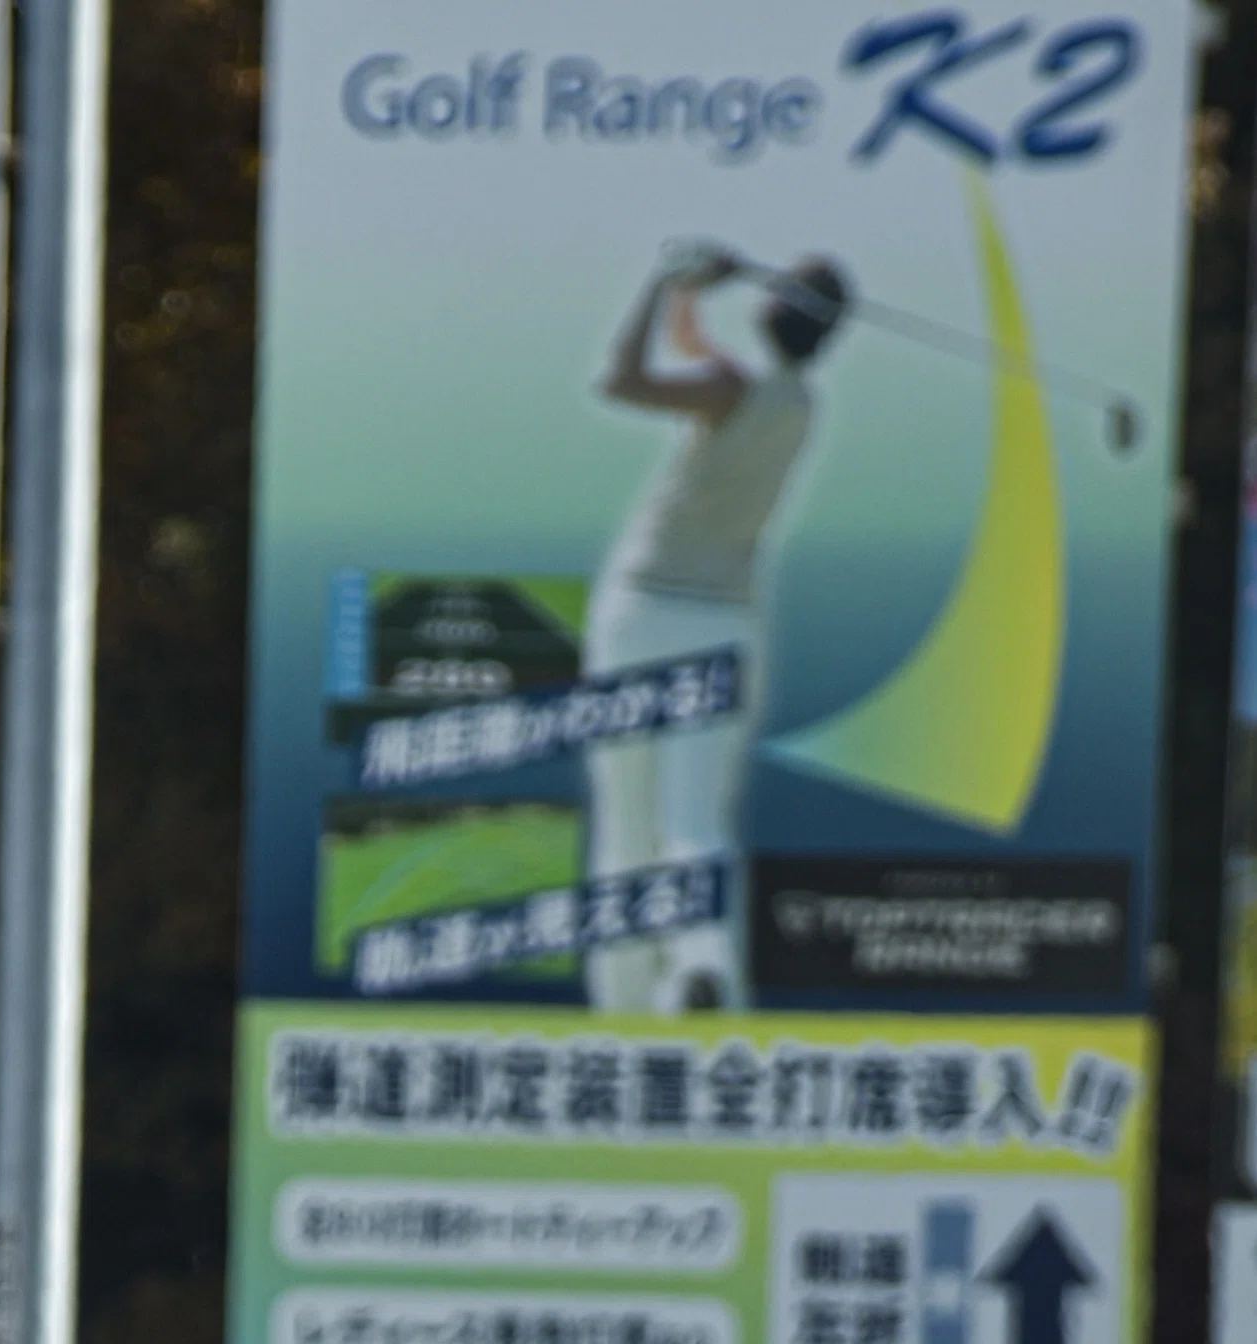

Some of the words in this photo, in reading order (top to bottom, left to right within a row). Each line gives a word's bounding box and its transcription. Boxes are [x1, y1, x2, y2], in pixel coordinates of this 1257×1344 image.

[343, 50, 526, 140] Golf
[545, 58, 822, 160] Range
[842, 9, 1139, 165] K2
